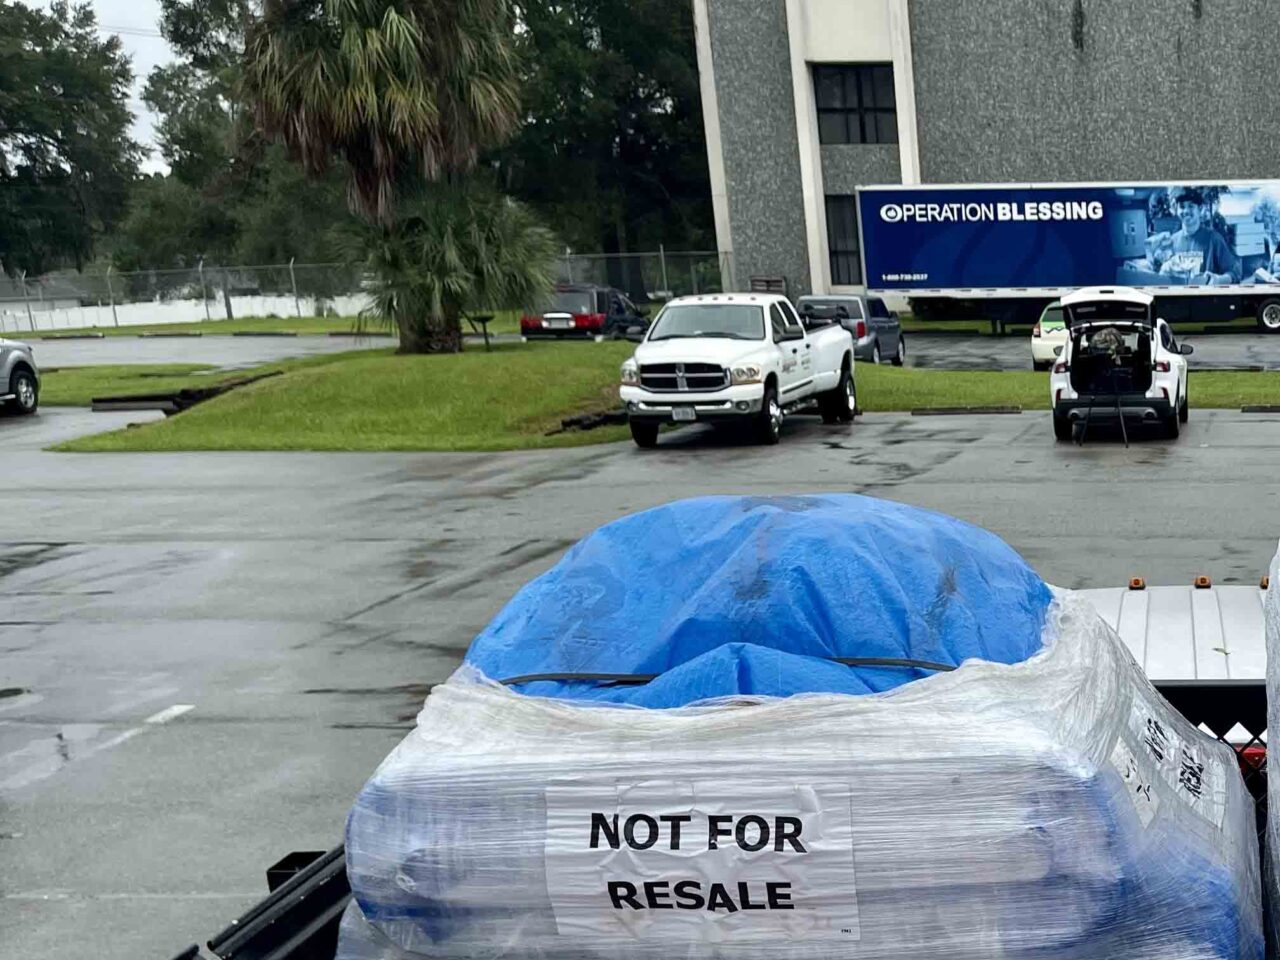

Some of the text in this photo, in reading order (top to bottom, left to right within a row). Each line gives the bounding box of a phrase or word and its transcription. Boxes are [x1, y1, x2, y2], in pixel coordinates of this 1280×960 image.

[880, 202, 1103, 222] OPERATION BLESSING
[588, 812, 808, 854] NOT FOR
[607, 879, 795, 914] RESALE
